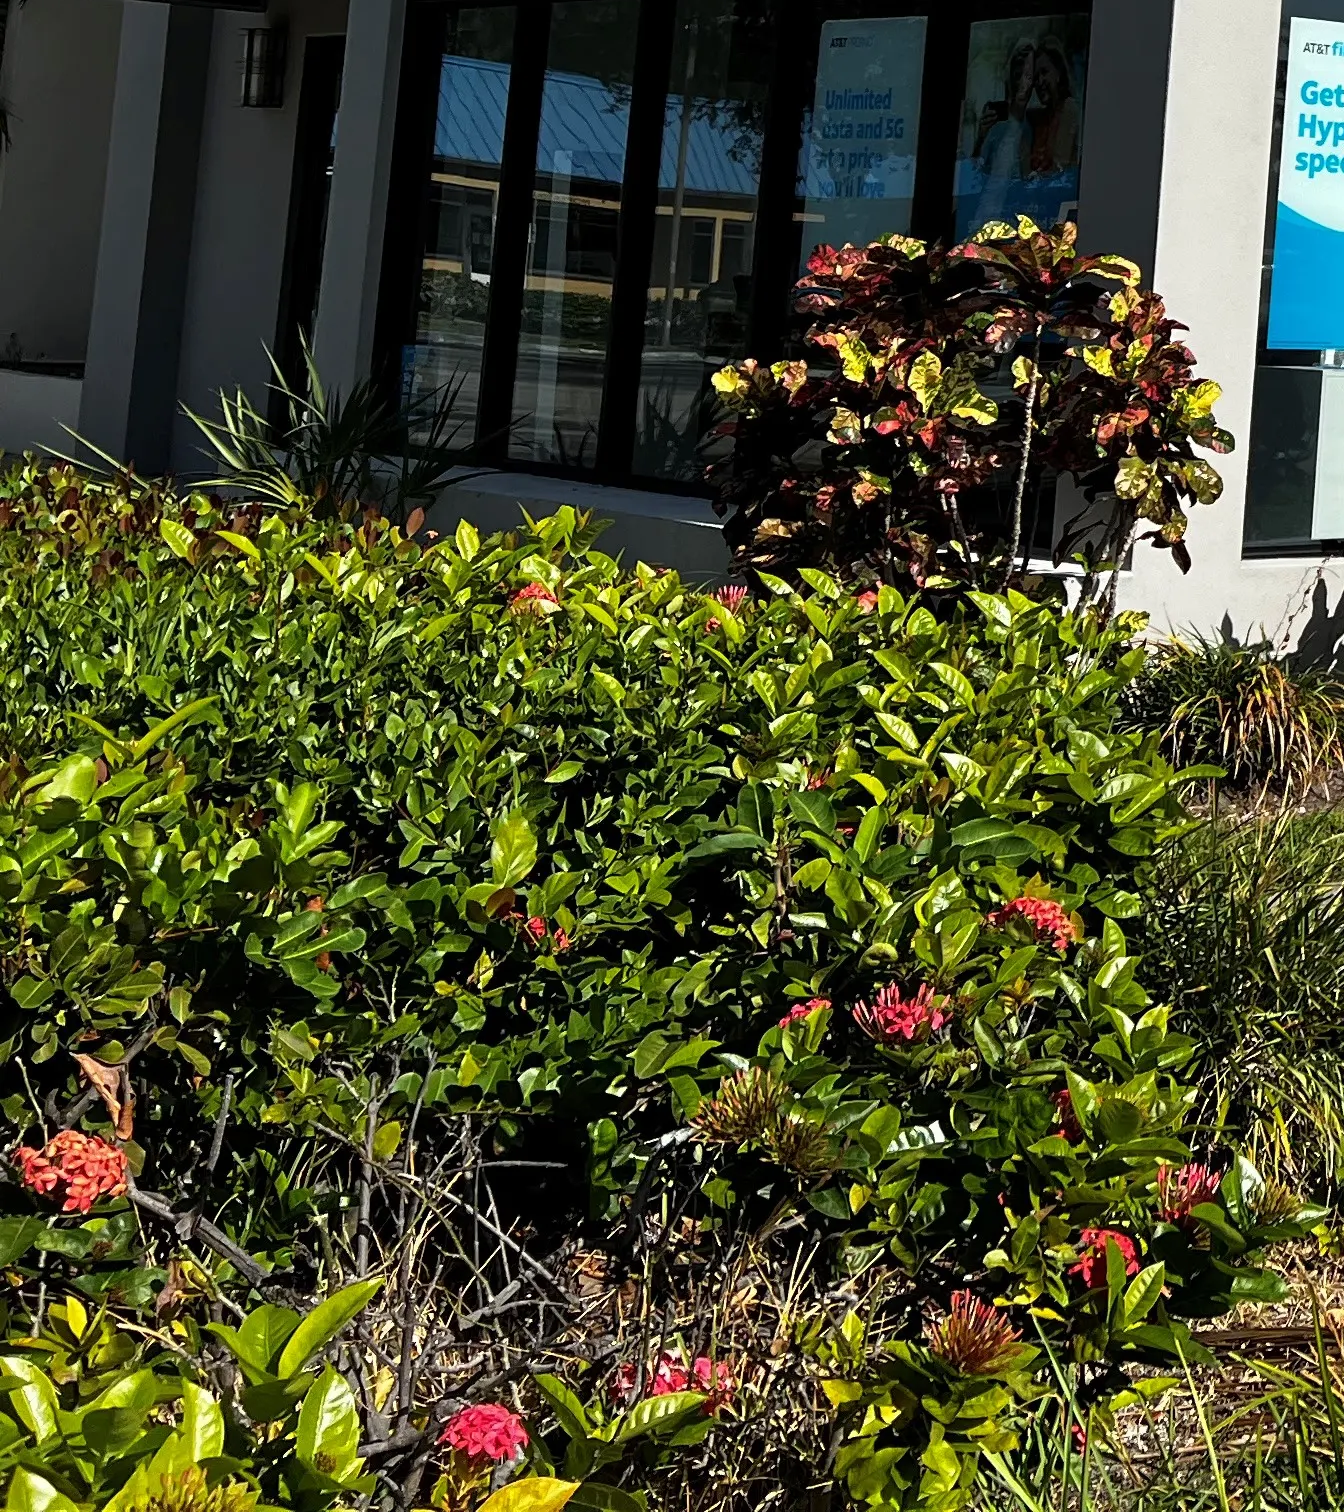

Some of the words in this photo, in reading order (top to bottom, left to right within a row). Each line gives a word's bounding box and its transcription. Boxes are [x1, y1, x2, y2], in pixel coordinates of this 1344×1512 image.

[1302, 41, 1331, 56] AT&T
[825, 88, 892, 110] Unlimited
[856, 117, 883, 139] and
[885, 118, 904, 139] 5G
[848, 147, 883, 173] price
[856, 175, 885, 198] love
